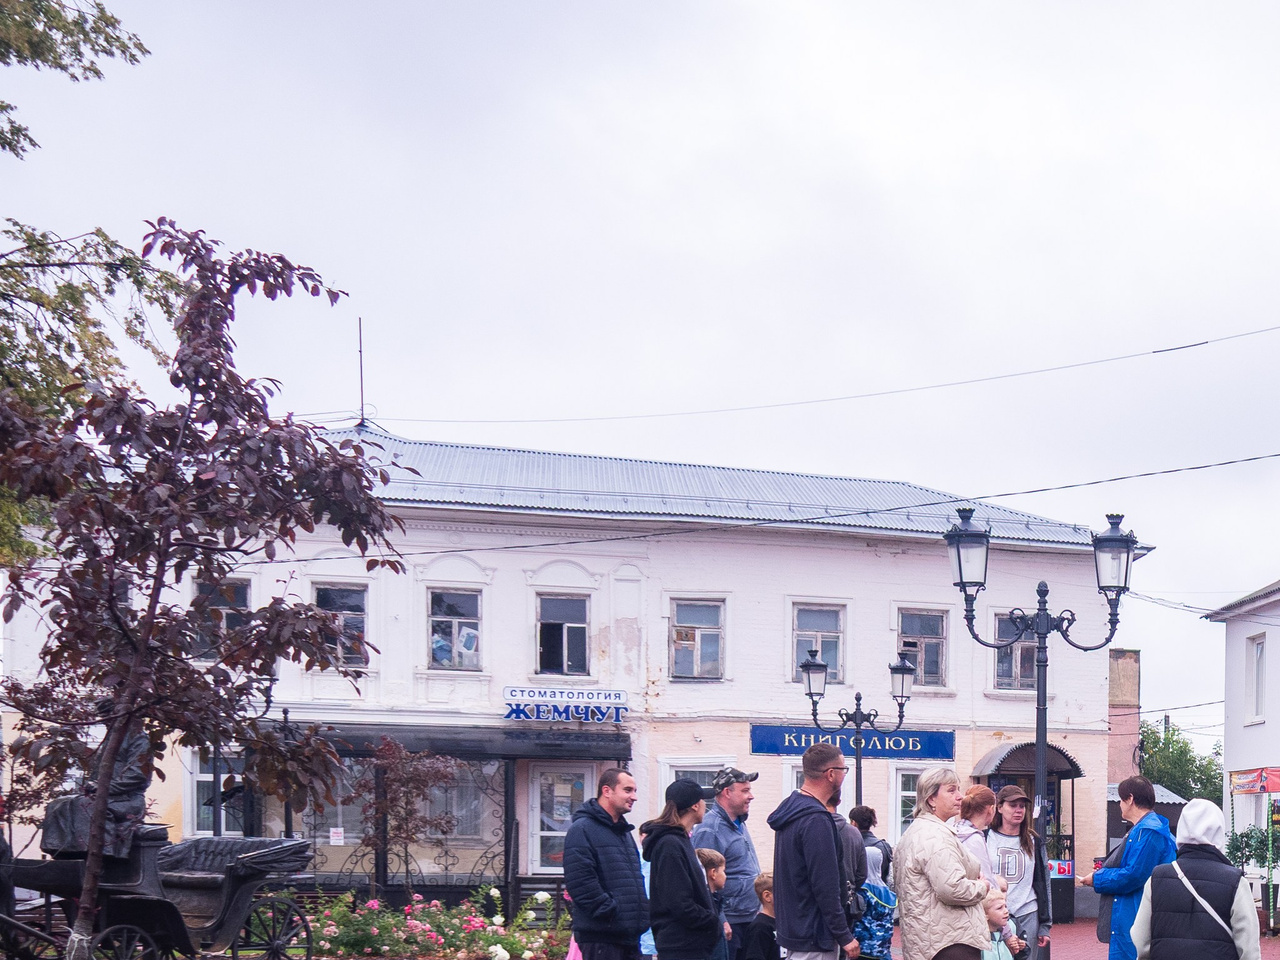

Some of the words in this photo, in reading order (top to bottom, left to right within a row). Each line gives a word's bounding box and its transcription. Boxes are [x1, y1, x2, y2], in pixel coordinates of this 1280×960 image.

[510, 689, 621, 700] стоматология
[503, 703, 629, 723] ЖЕМЧУГ
[996, 847, 1026, 884] D
